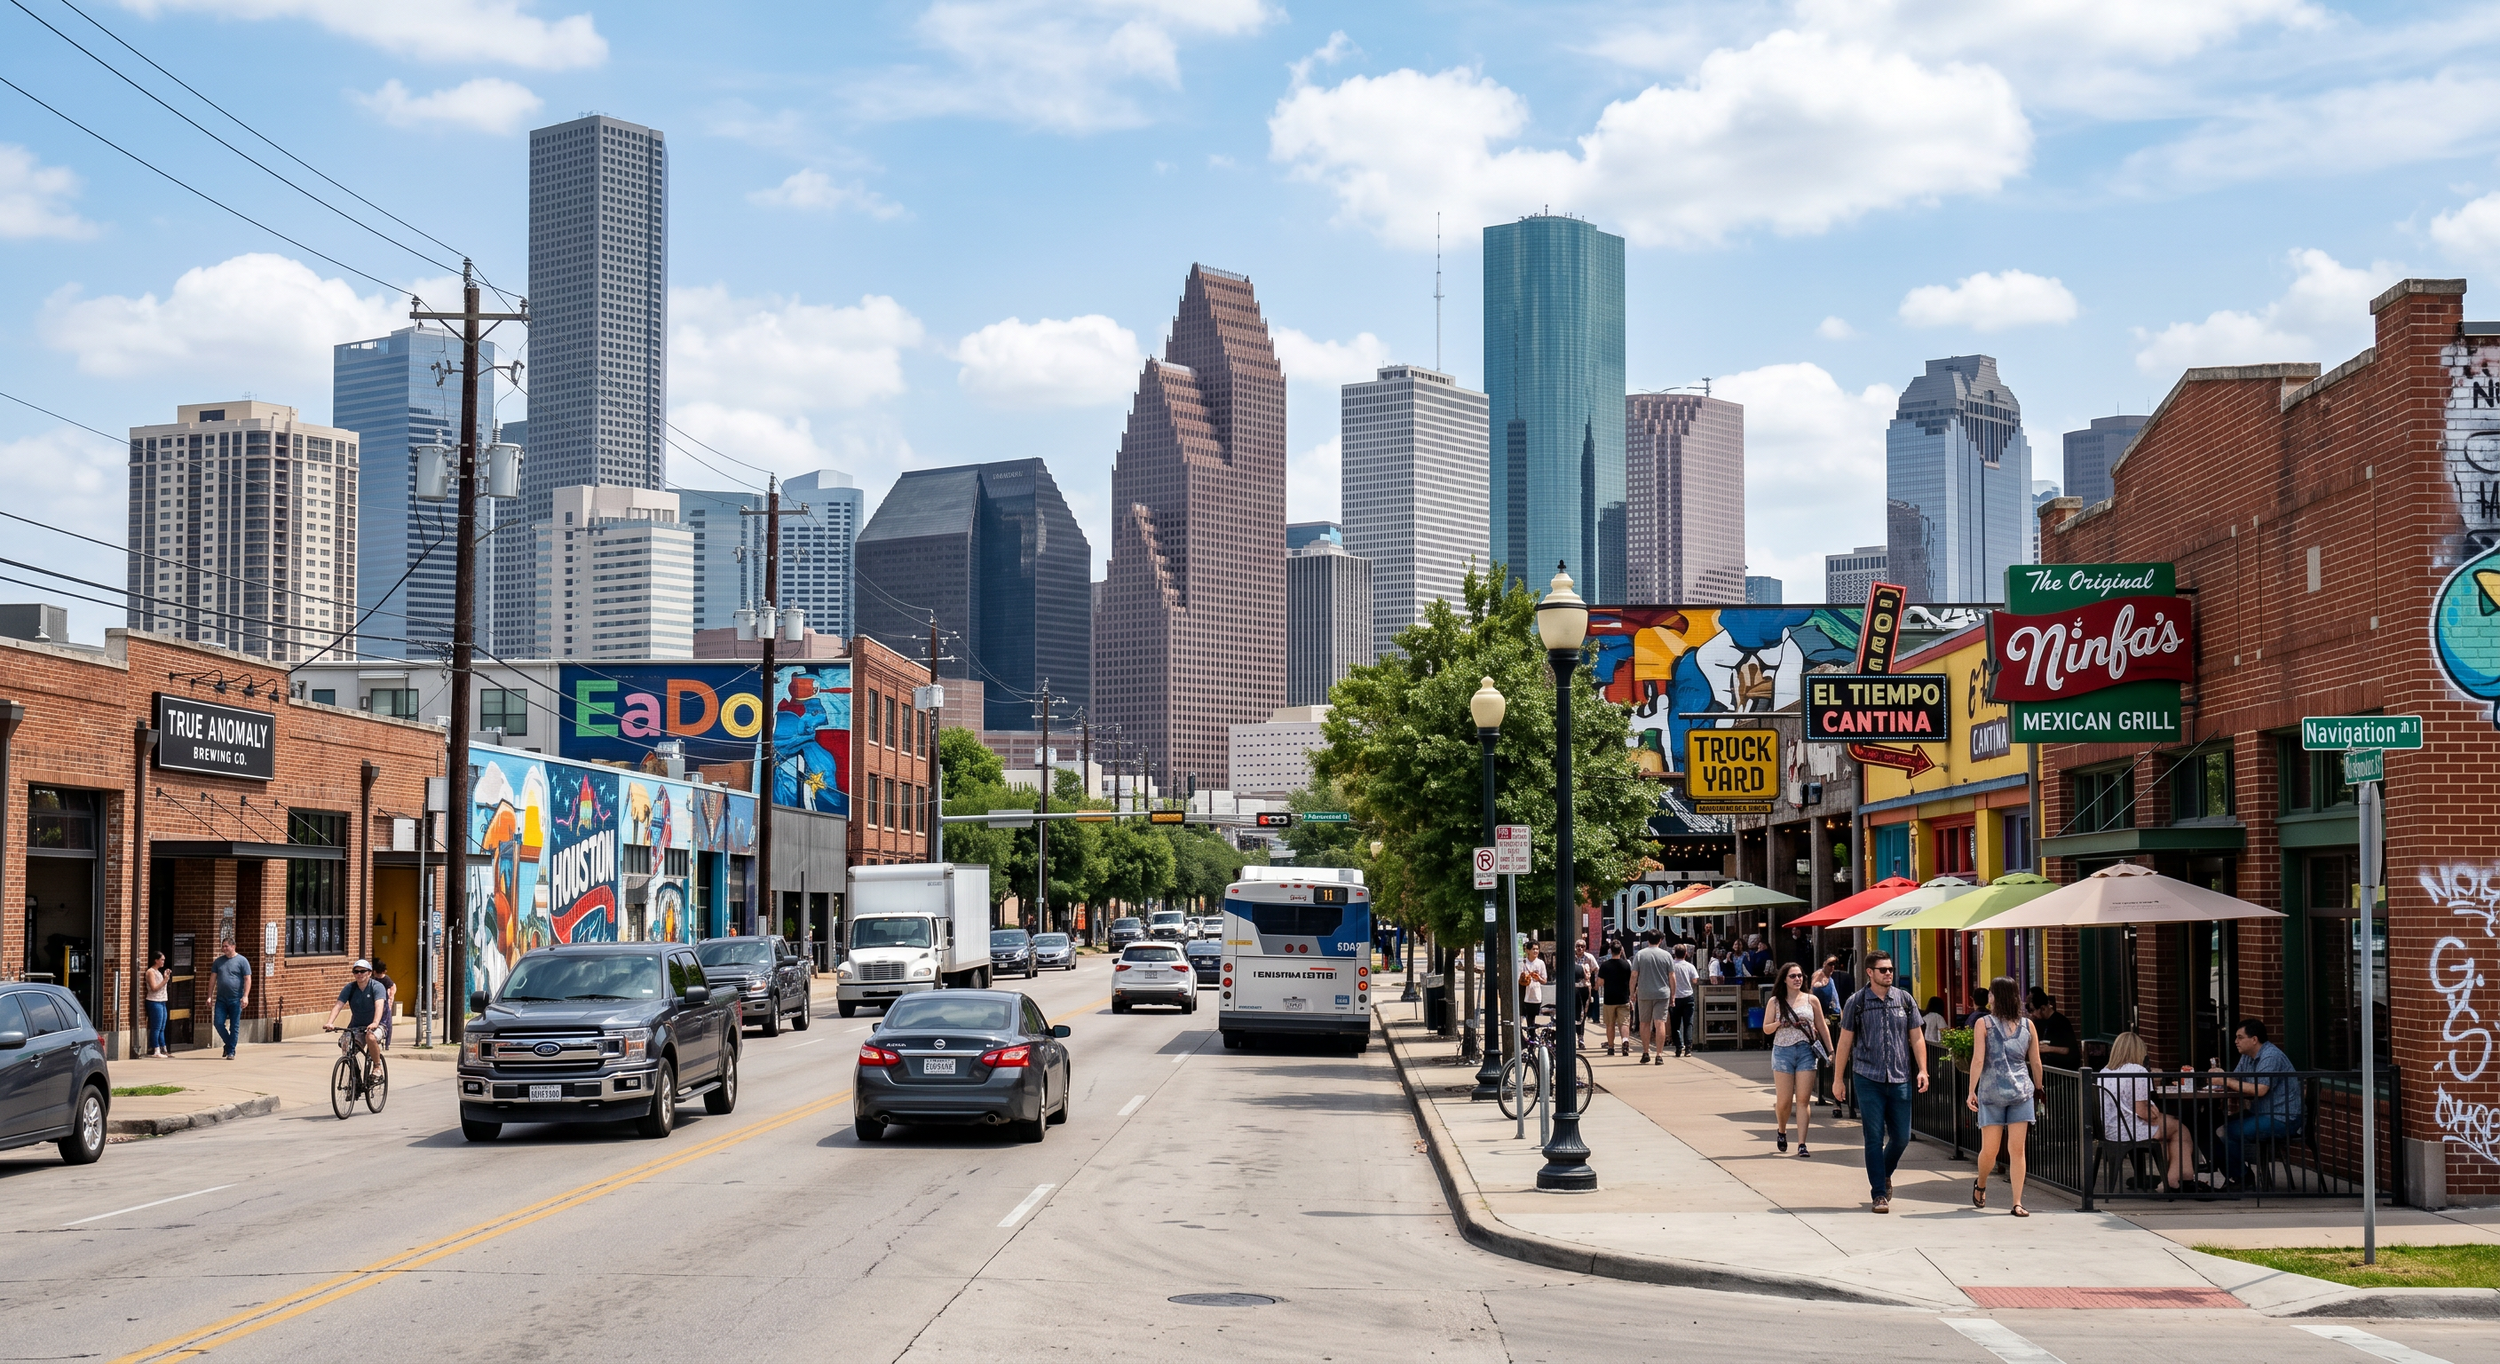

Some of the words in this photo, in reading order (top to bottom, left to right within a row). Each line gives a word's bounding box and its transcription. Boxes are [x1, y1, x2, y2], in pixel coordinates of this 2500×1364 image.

[2026, 569, 2063, 593] The
[2068, 568, 2154, 597] Original
[2006, 604, 2184, 691] Ninfa's
[576, 679, 763, 738] EaDo
[1814, 683, 1842, 706] EL
[1848, 683, 1940, 706] TIEMPO
[168, 709, 203, 740] TRUE
[207, 716, 268, 749] ANOMALY
[1822, 711, 1932, 733] CANTINA
[2023, 711, 2111, 731] MEXICAN
[2118, 711, 2175, 730] GRILL
[2306, 721, 2396, 748] Navigation
[193, 746, 231, 764] BREWING
[234, 752, 247, 766] CO.
[1694, 736, 1772, 764] TRUCK
[1703, 765, 1764, 793] YARD
[552, 829, 615, 911] HOUSTON
[1323, 889, 1333, 901] 11
